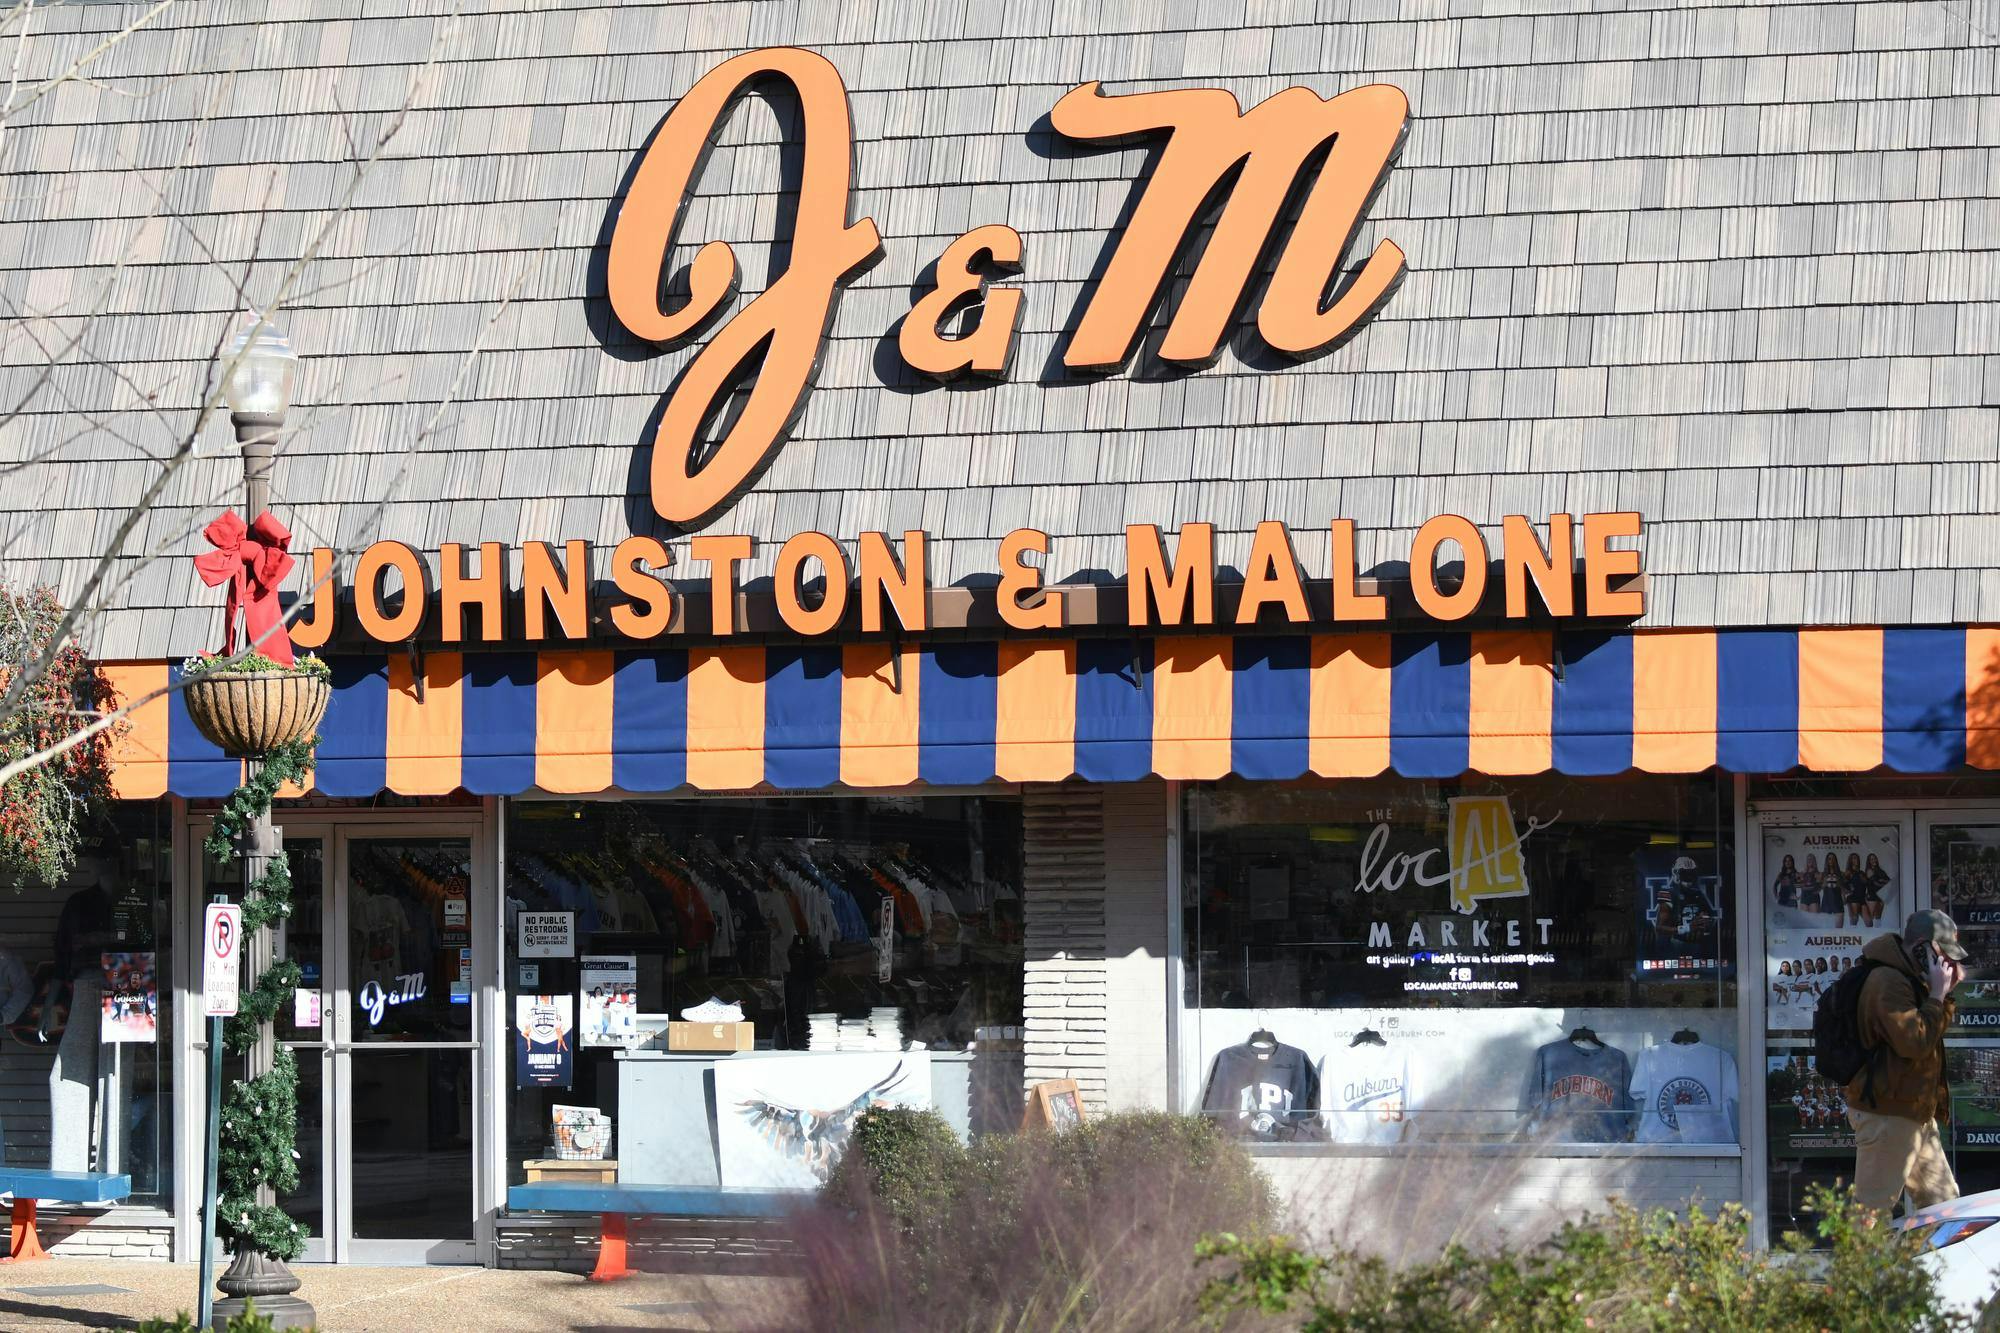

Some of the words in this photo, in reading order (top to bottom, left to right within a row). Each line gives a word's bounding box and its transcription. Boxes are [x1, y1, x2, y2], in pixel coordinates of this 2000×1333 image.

[607, 46, 884, 525] J
[899, 225, 1025, 376] &
[1051, 82, 1410, 371] M
[288, 530, 926, 648] JOHNSTON
[997, 528, 1063, 629] &
[1126, 511, 1646, 627] MALONE
[1366, 808, 1392, 823] THE
[1803, 836, 1860, 846] AUBURN
[526, 916, 536, 924] NO
[540, 916, 567, 924] PUBLIC
[524, 926, 568, 934] RESTROOMS
[1368, 918, 1553, 948] MARKET
[1804, 936, 1862, 946] AUBURN
[1366, 955, 1380, 964] art
[1383, 954, 1415, 968] gallery
[1482, 953, 1490, 963] &
[1490, 953, 1526, 963] artisan
[1526, 952, 1554, 966] goods
[224, 962, 234, 976] Min
[208, 978, 234, 996] Loading
[1404, 981, 1518, 991] LOCALMARKETAUBURN.COM
[212, 995, 229, 1010] Zone
[360, 981, 388, 1026] J
[389, 990, 400, 1006] &
[396, 972, 426, 1002] M
[528, 1054, 556, 1064] JANUARY
[1344, 1077, 1400, 1102] Auburn
[1552, 1074, 1614, 1105] AUBURN
